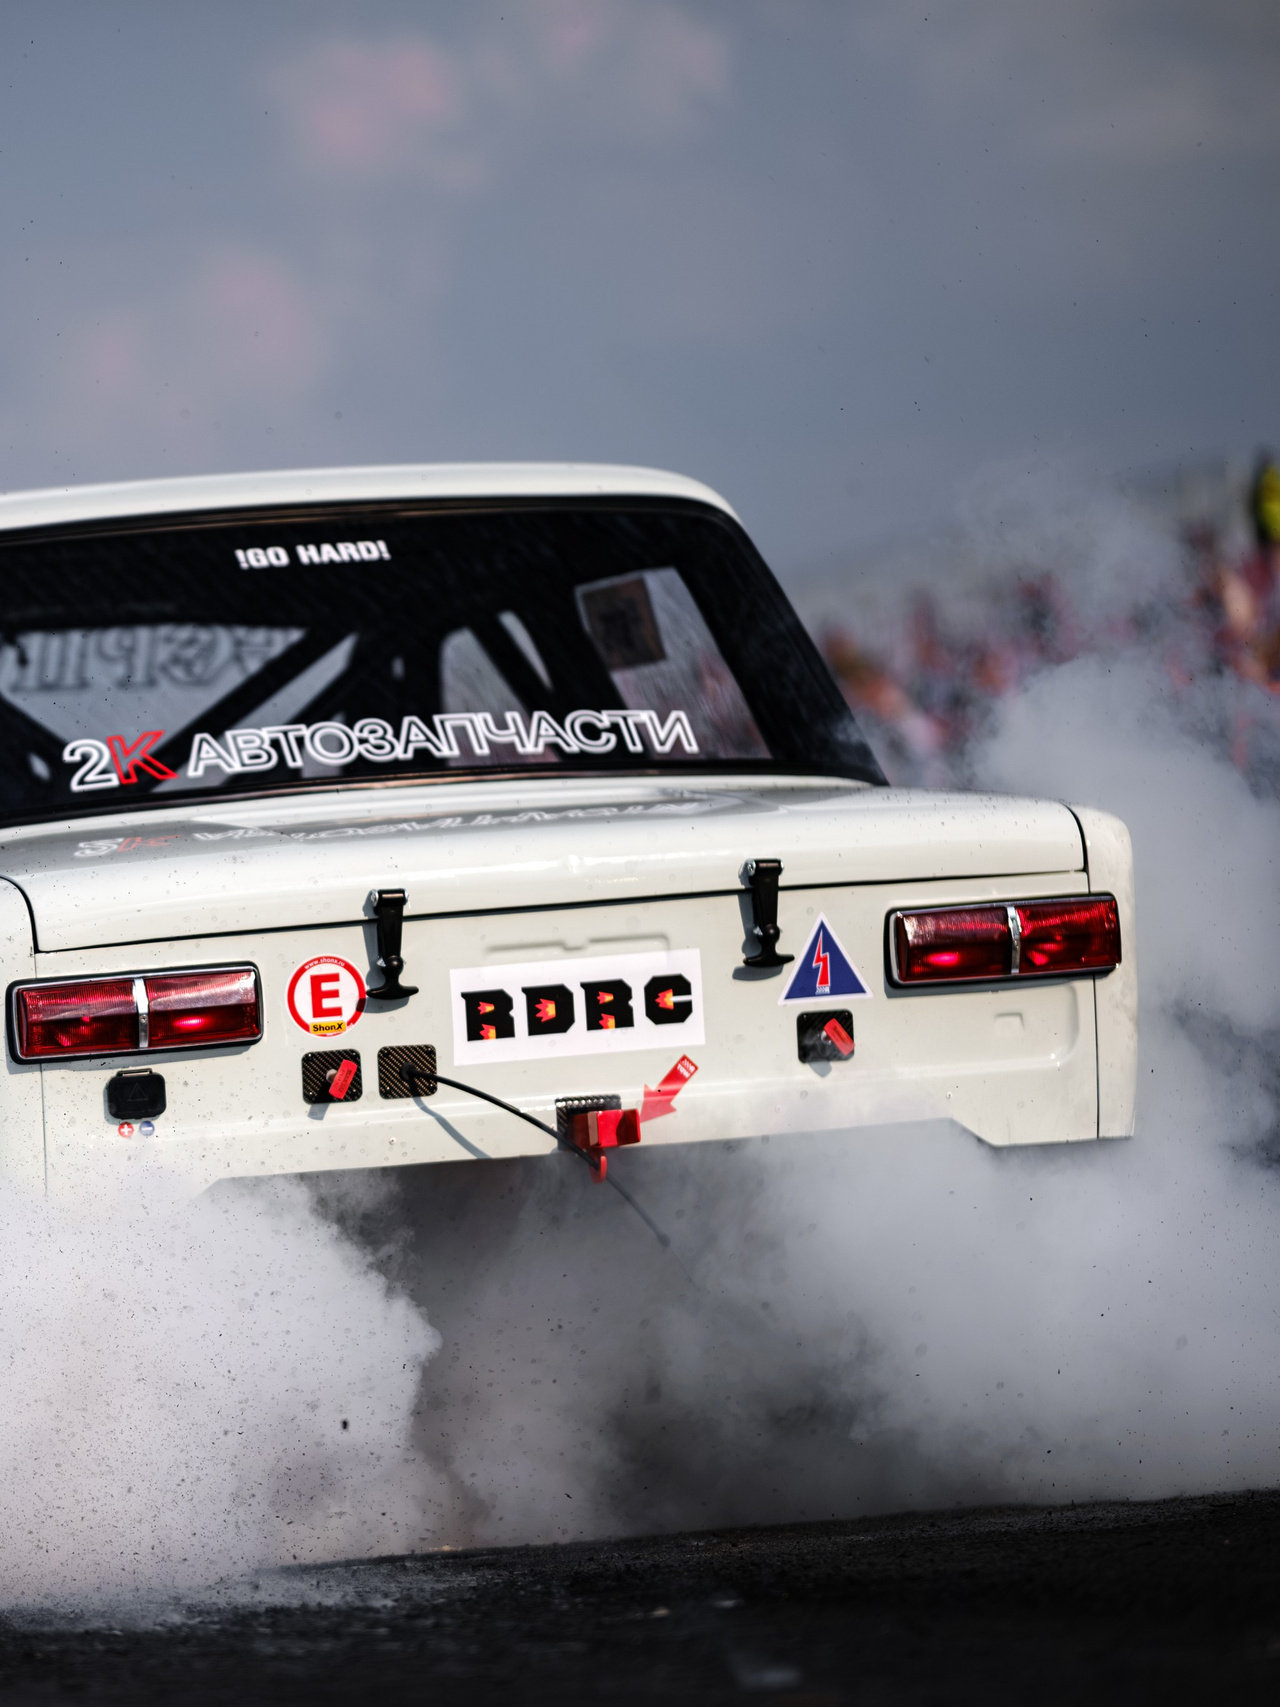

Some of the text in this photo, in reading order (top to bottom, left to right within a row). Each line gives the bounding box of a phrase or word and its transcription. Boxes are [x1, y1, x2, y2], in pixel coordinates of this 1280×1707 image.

[234, 540, 391, 570] !GO HARD!
[187, 709, 699, 778] АВТОЗАПЧАСТИ
[304, 957, 345, 970] www.shonx.ru
[310, 973, 343, 1018] E
[461, 973, 693, 1042] RDRC
[312, 1022, 343, 1032] ShonX
[677, 1063, 691, 1078] TOW
